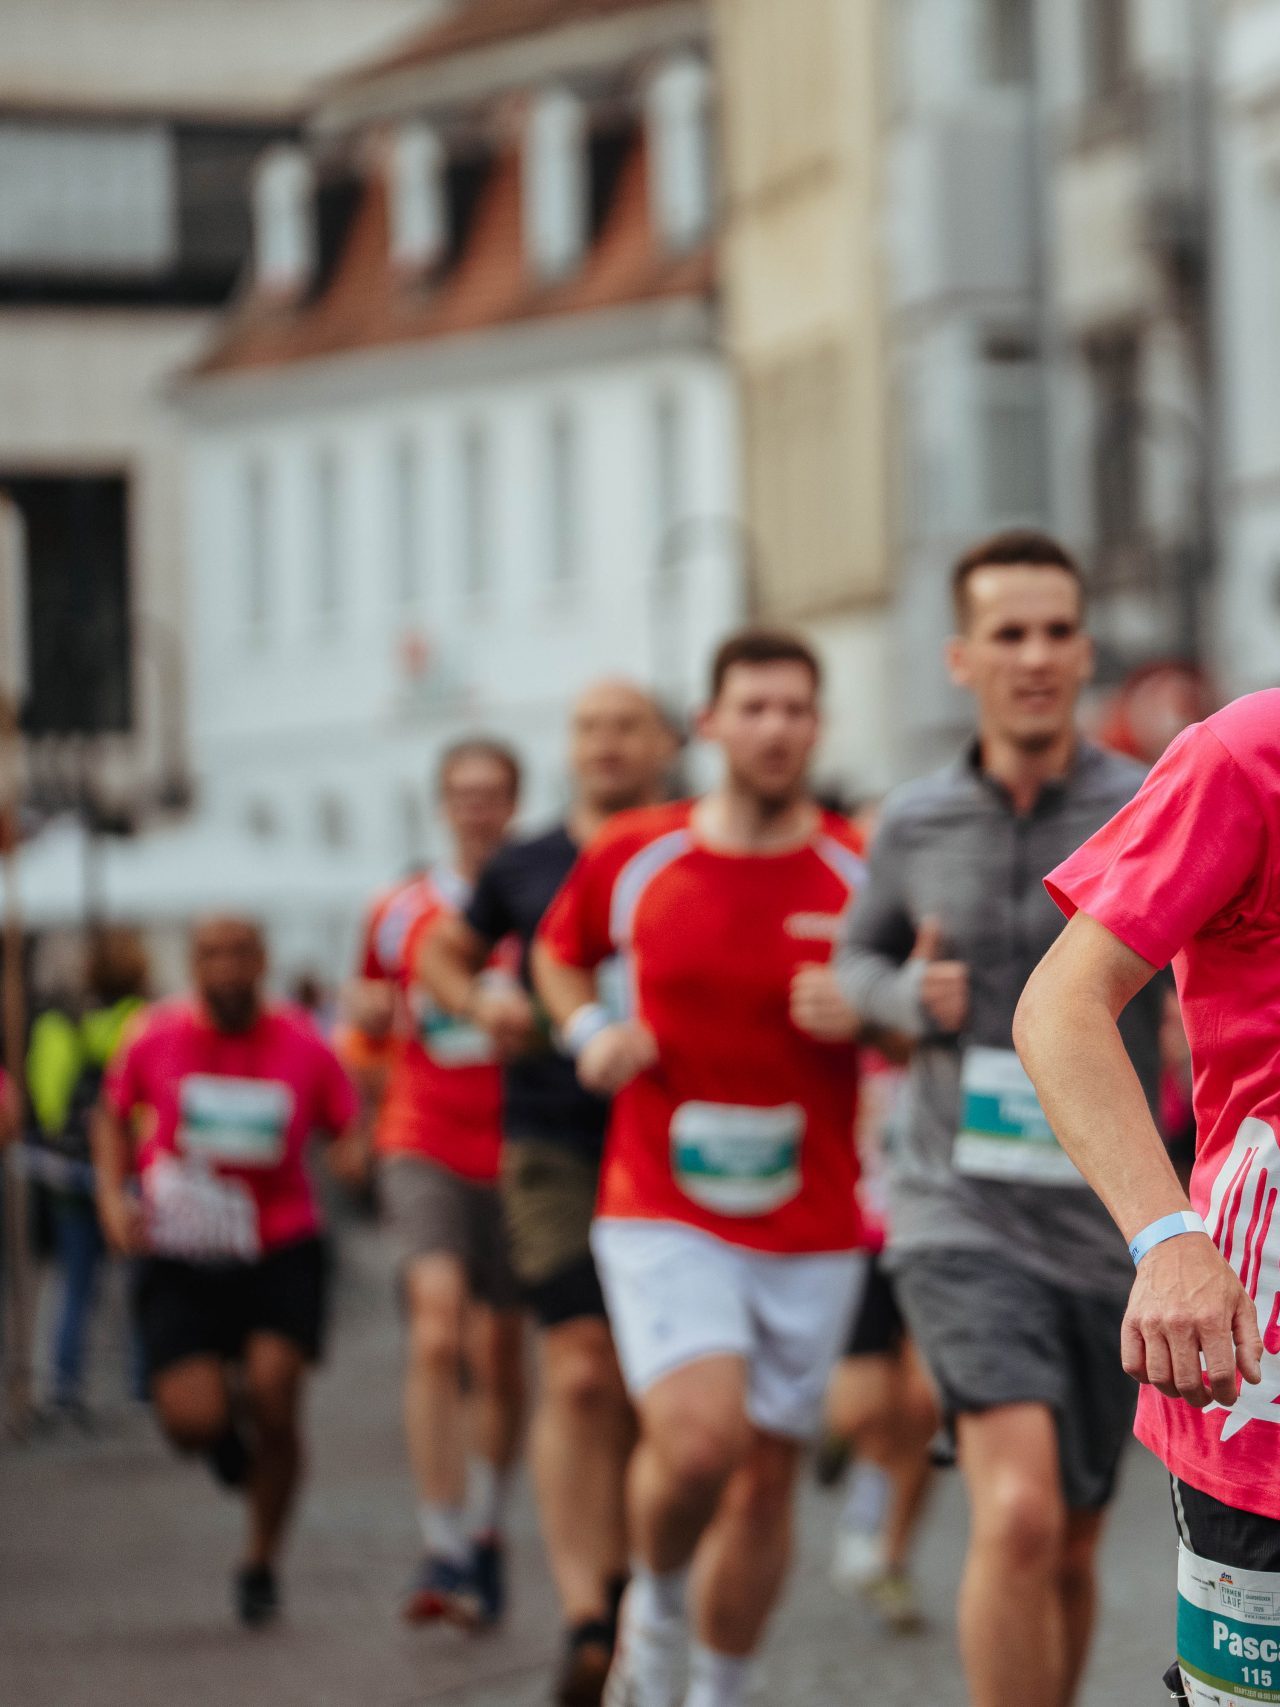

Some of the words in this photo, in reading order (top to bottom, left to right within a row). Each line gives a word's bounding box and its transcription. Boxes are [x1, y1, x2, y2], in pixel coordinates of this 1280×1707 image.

[1221, 1572, 1232, 1580] dm
[1221, 1587, 1241, 1598] FIRMEN
[1222, 1594, 1241, 1609] LAUF
[1242, 1666, 1272, 1687] 115
